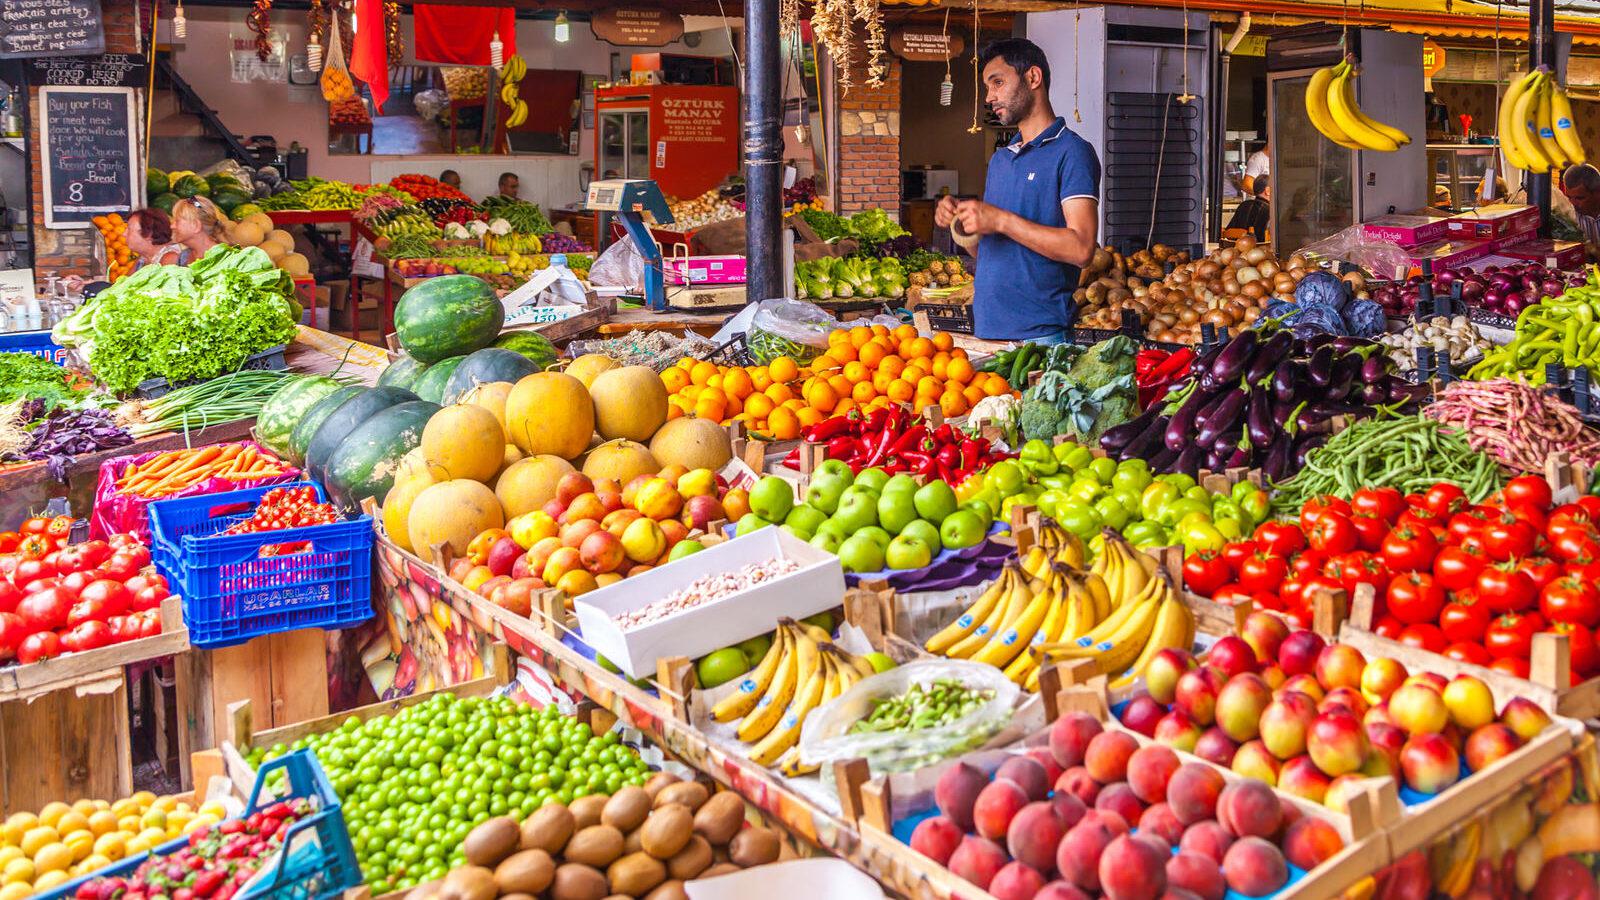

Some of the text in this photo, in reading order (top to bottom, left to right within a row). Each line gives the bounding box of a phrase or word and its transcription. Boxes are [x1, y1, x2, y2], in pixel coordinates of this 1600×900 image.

[70, 100, 90, 115] your
[661, 97, 725, 109] ÖZTÜRK
[664, 109, 722, 118] MANAV
[49, 115, 112, 126] or meat next
[75, 134, 95, 147] you
[86, 162, 96, 170] or
[69, 182, 84, 202] 8
